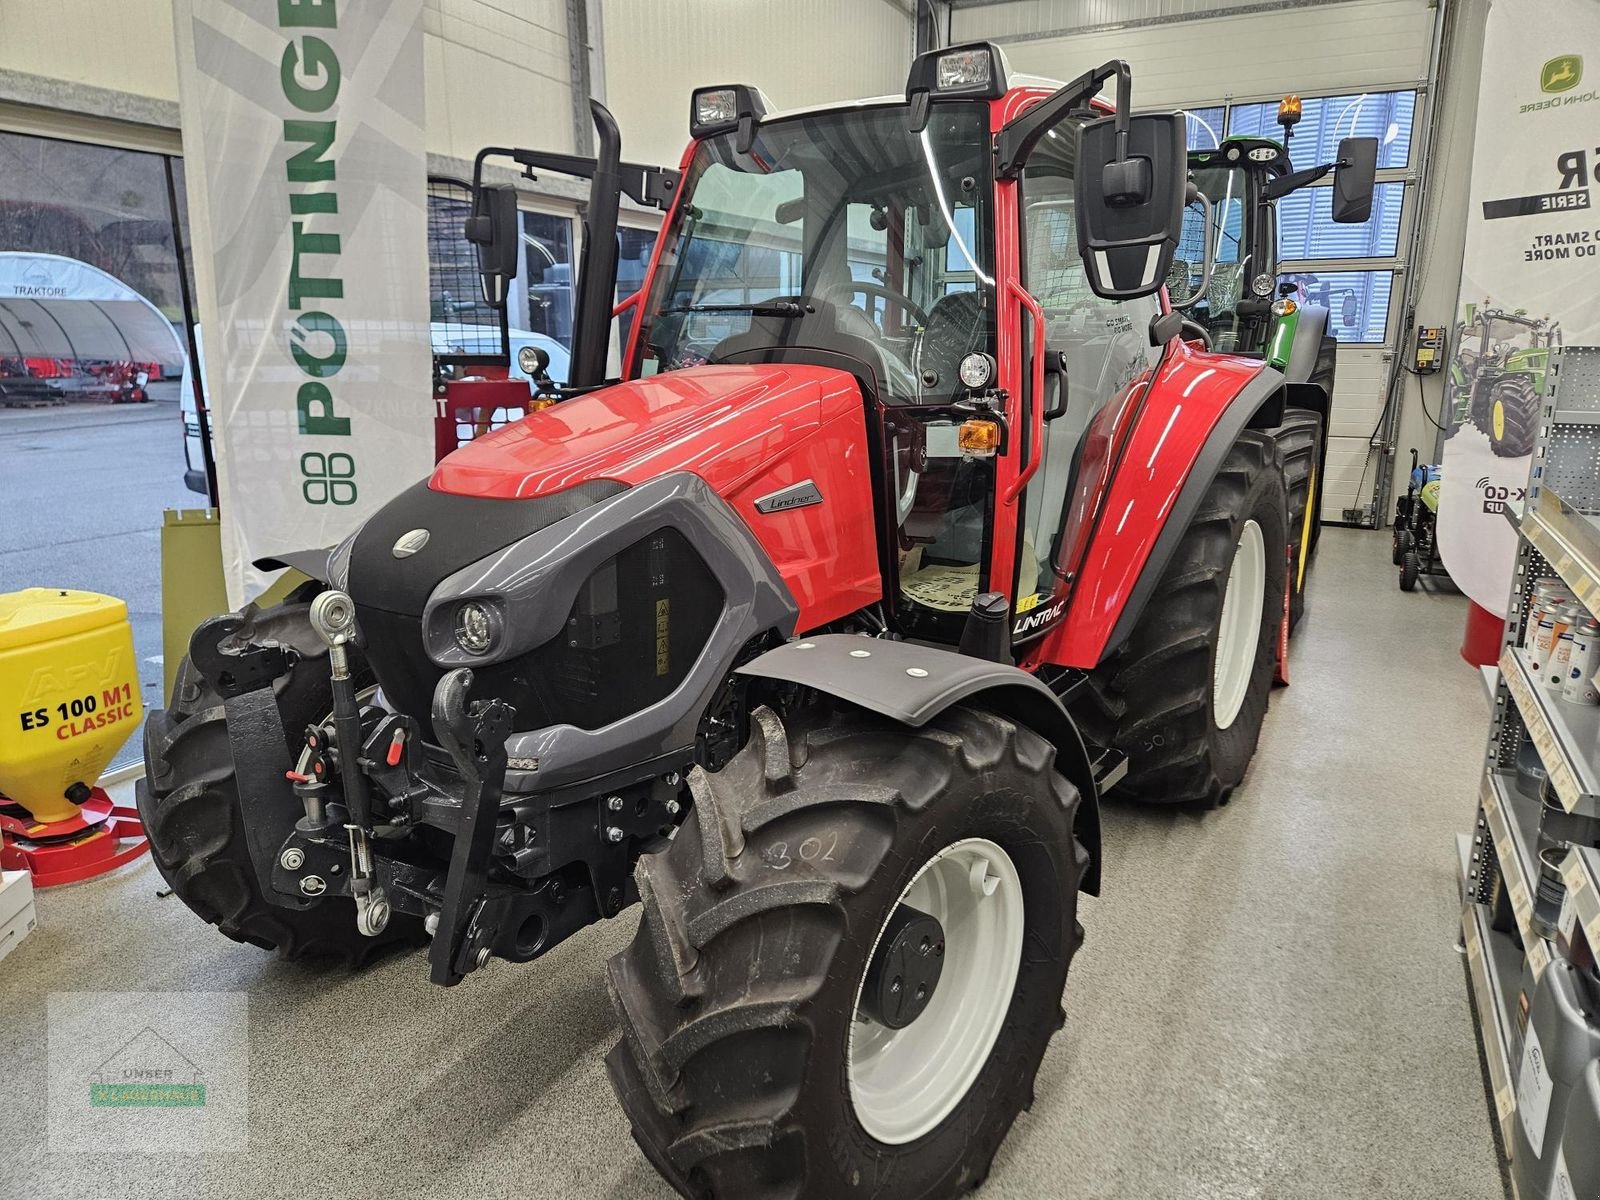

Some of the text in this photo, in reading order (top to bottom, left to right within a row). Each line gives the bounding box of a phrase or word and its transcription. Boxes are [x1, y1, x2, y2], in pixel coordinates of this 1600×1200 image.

[13, 286, 67, 297] TRAKTORE
[769, 494, 814, 510] Lindner
[1012, 600, 1065, 635] LINTRAC
[19, 646, 125, 708] APV
[20, 682, 132, 731] ES 100 M1
[56, 702, 133, 740] CLASSIC
